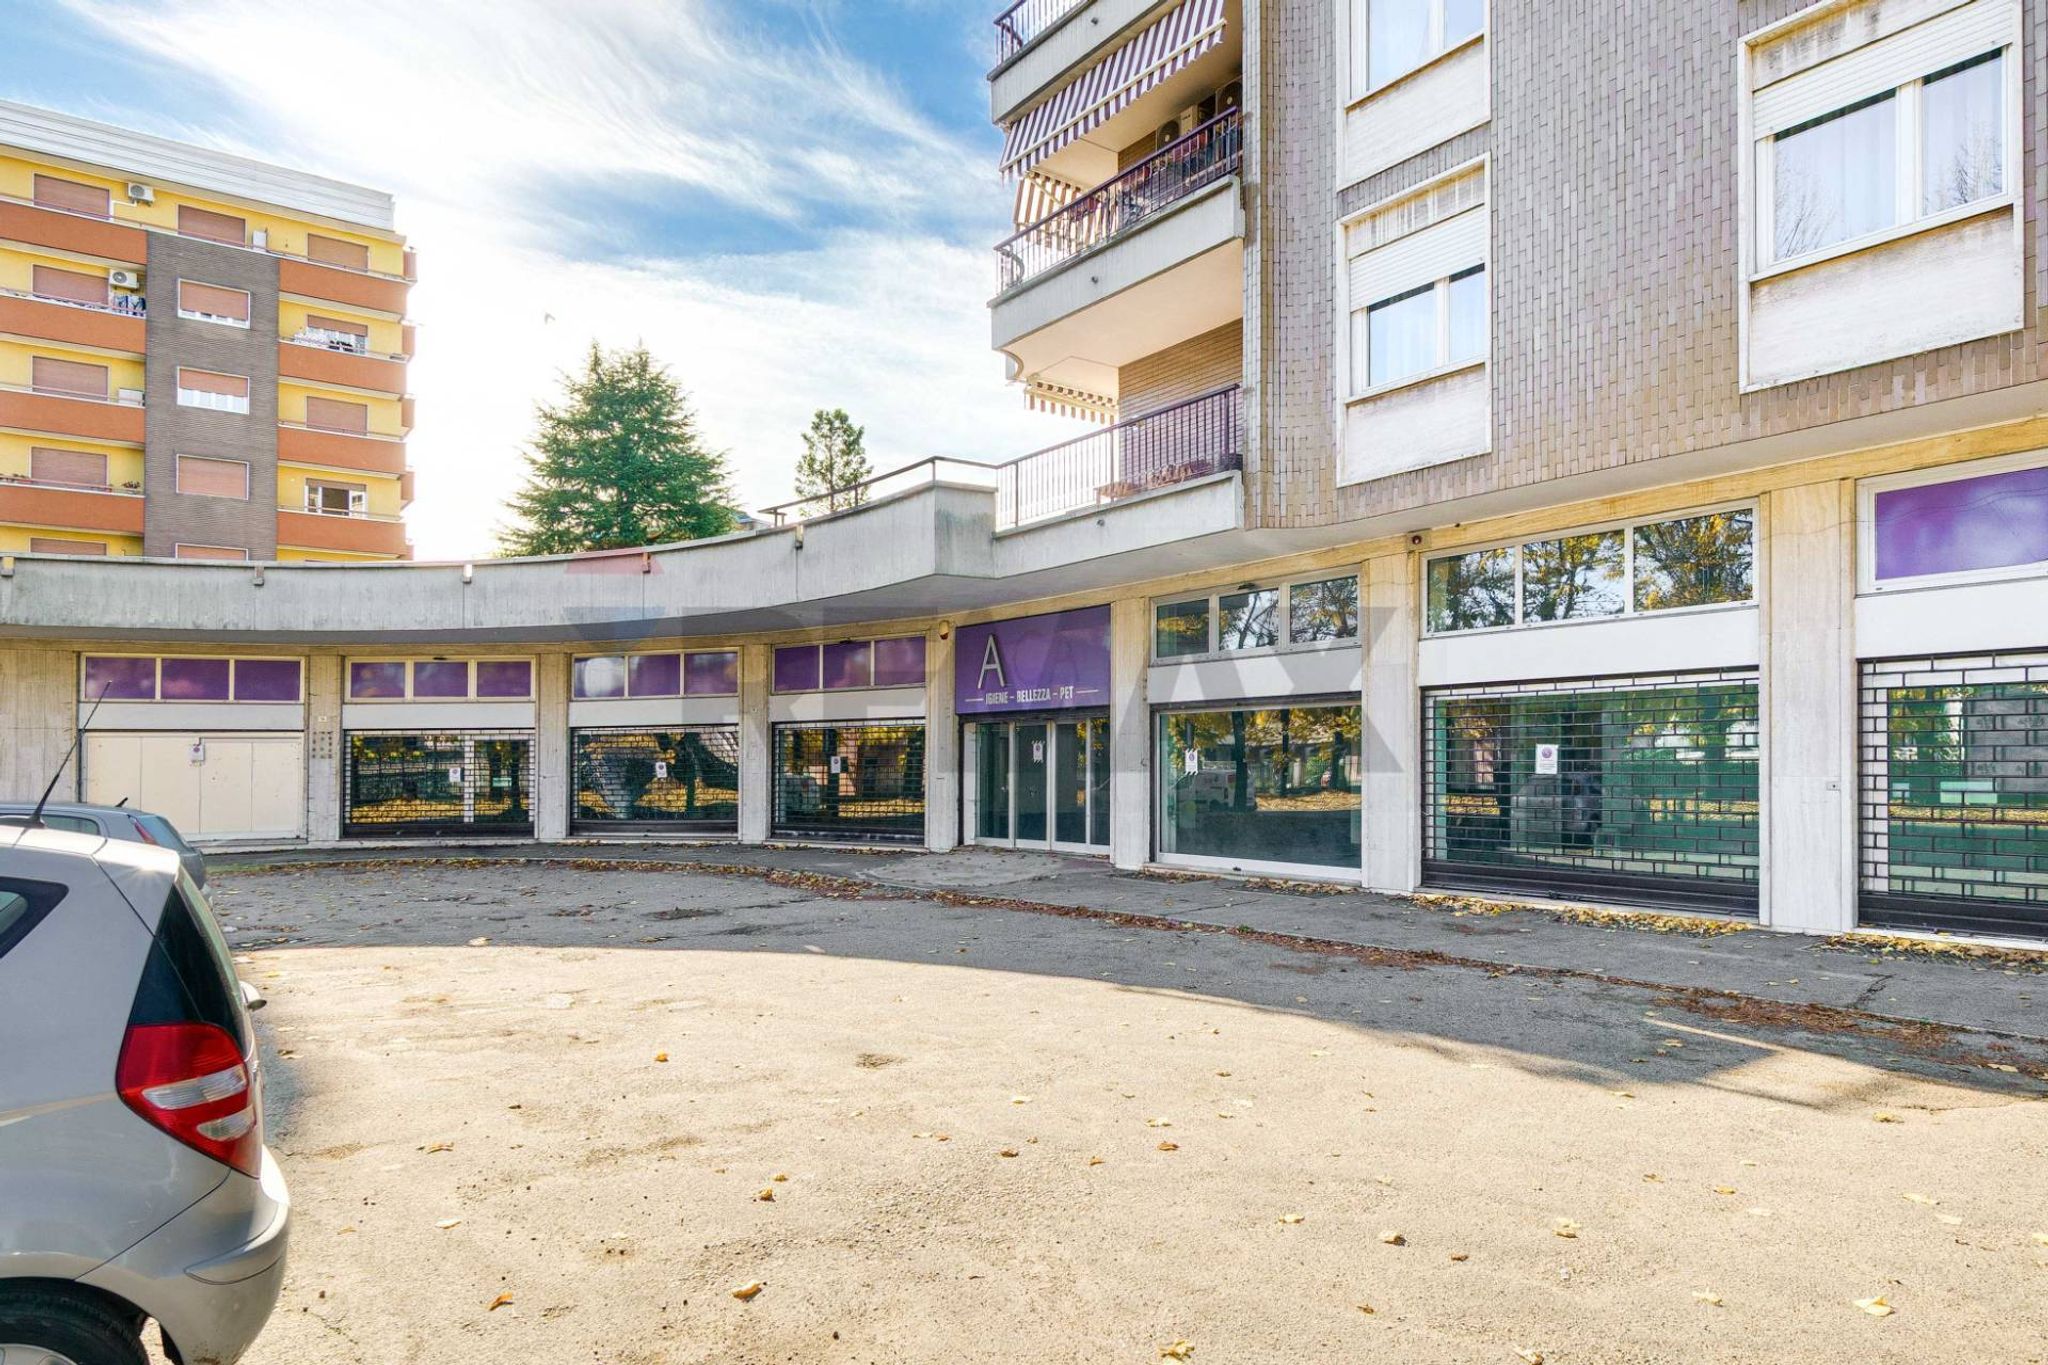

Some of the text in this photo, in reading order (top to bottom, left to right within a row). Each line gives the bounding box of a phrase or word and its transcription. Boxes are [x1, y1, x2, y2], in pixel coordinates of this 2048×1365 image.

[985, 685, 1074, 705] IGIENE BELLEZZA PET
